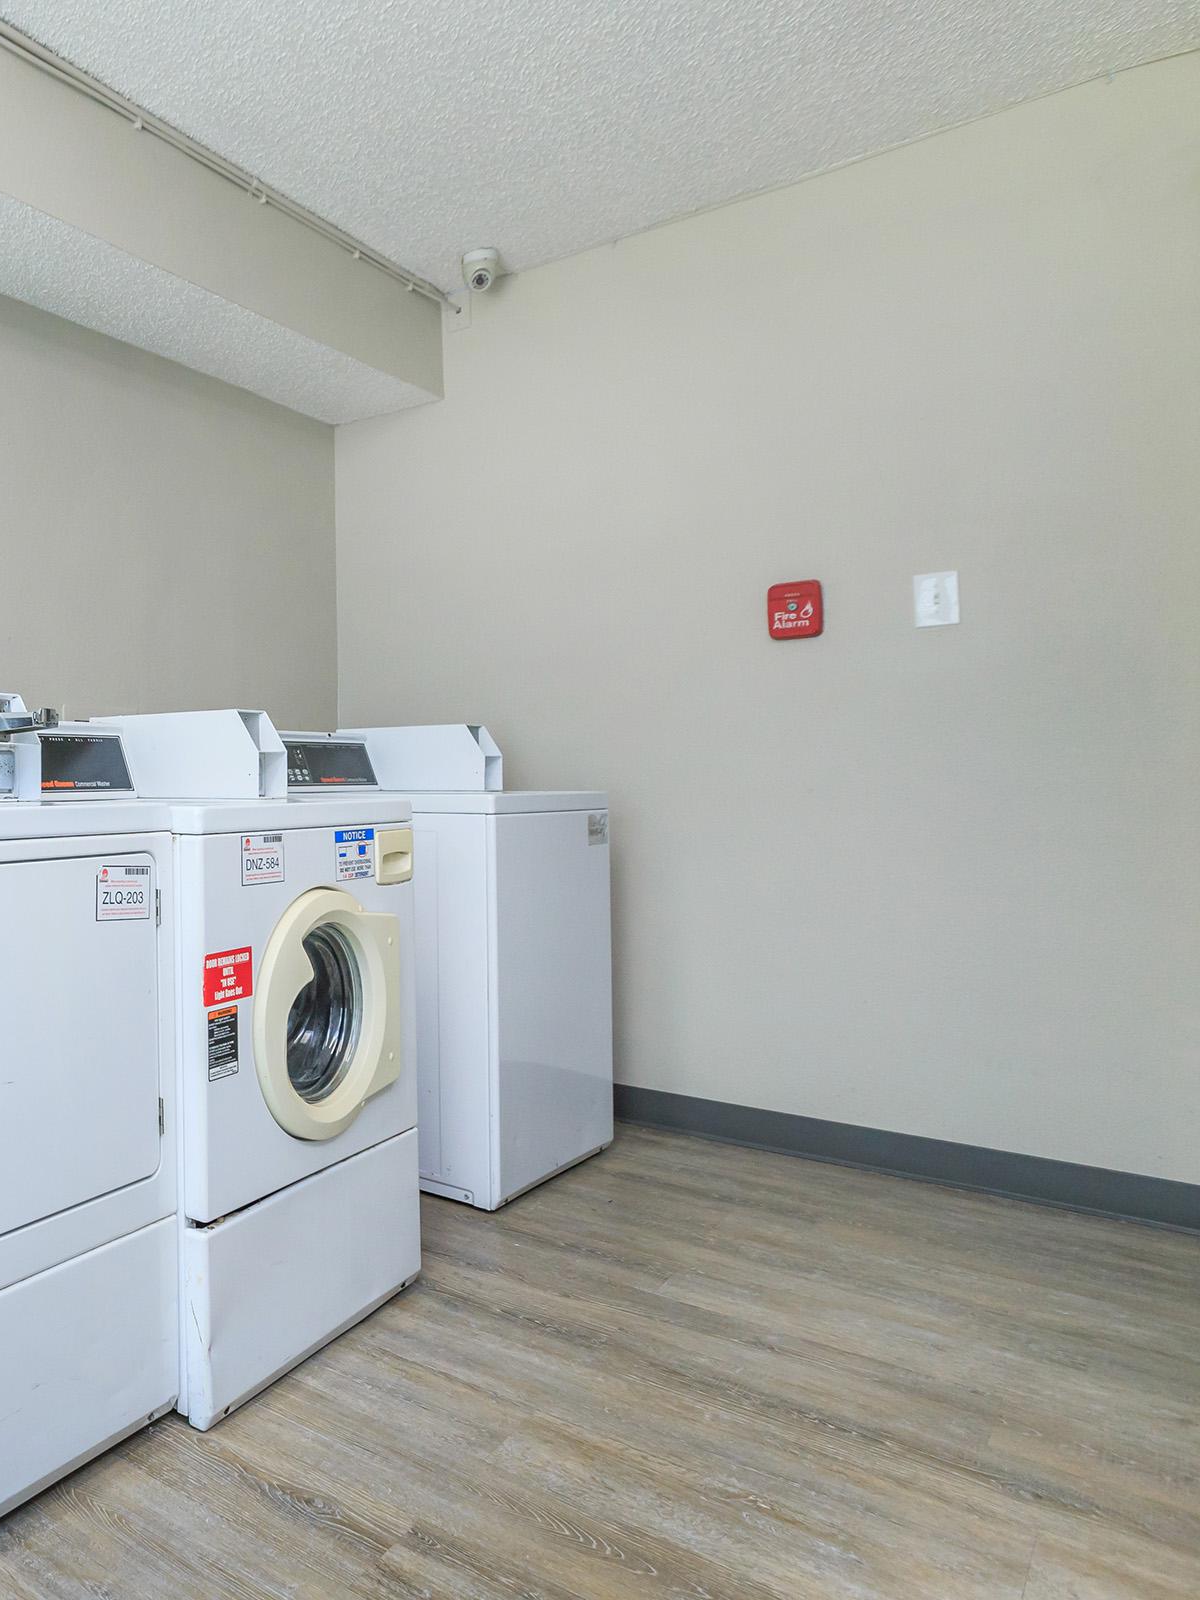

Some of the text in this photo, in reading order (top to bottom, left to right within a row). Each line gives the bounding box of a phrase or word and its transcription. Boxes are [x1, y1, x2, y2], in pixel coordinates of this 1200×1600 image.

[774, 611, 797, 621] Fire
[772, 619, 810, 630] Alarm
[343, 831, 366, 840] NOTICE
[246, 857, 279, 871] DNZ-584
[102, 891, 144, 905] ZLQ-203
[206, 952, 250, 969] DOOR REMAINS LOCKED
[214, 986, 243, 1000] Light Goes Out
